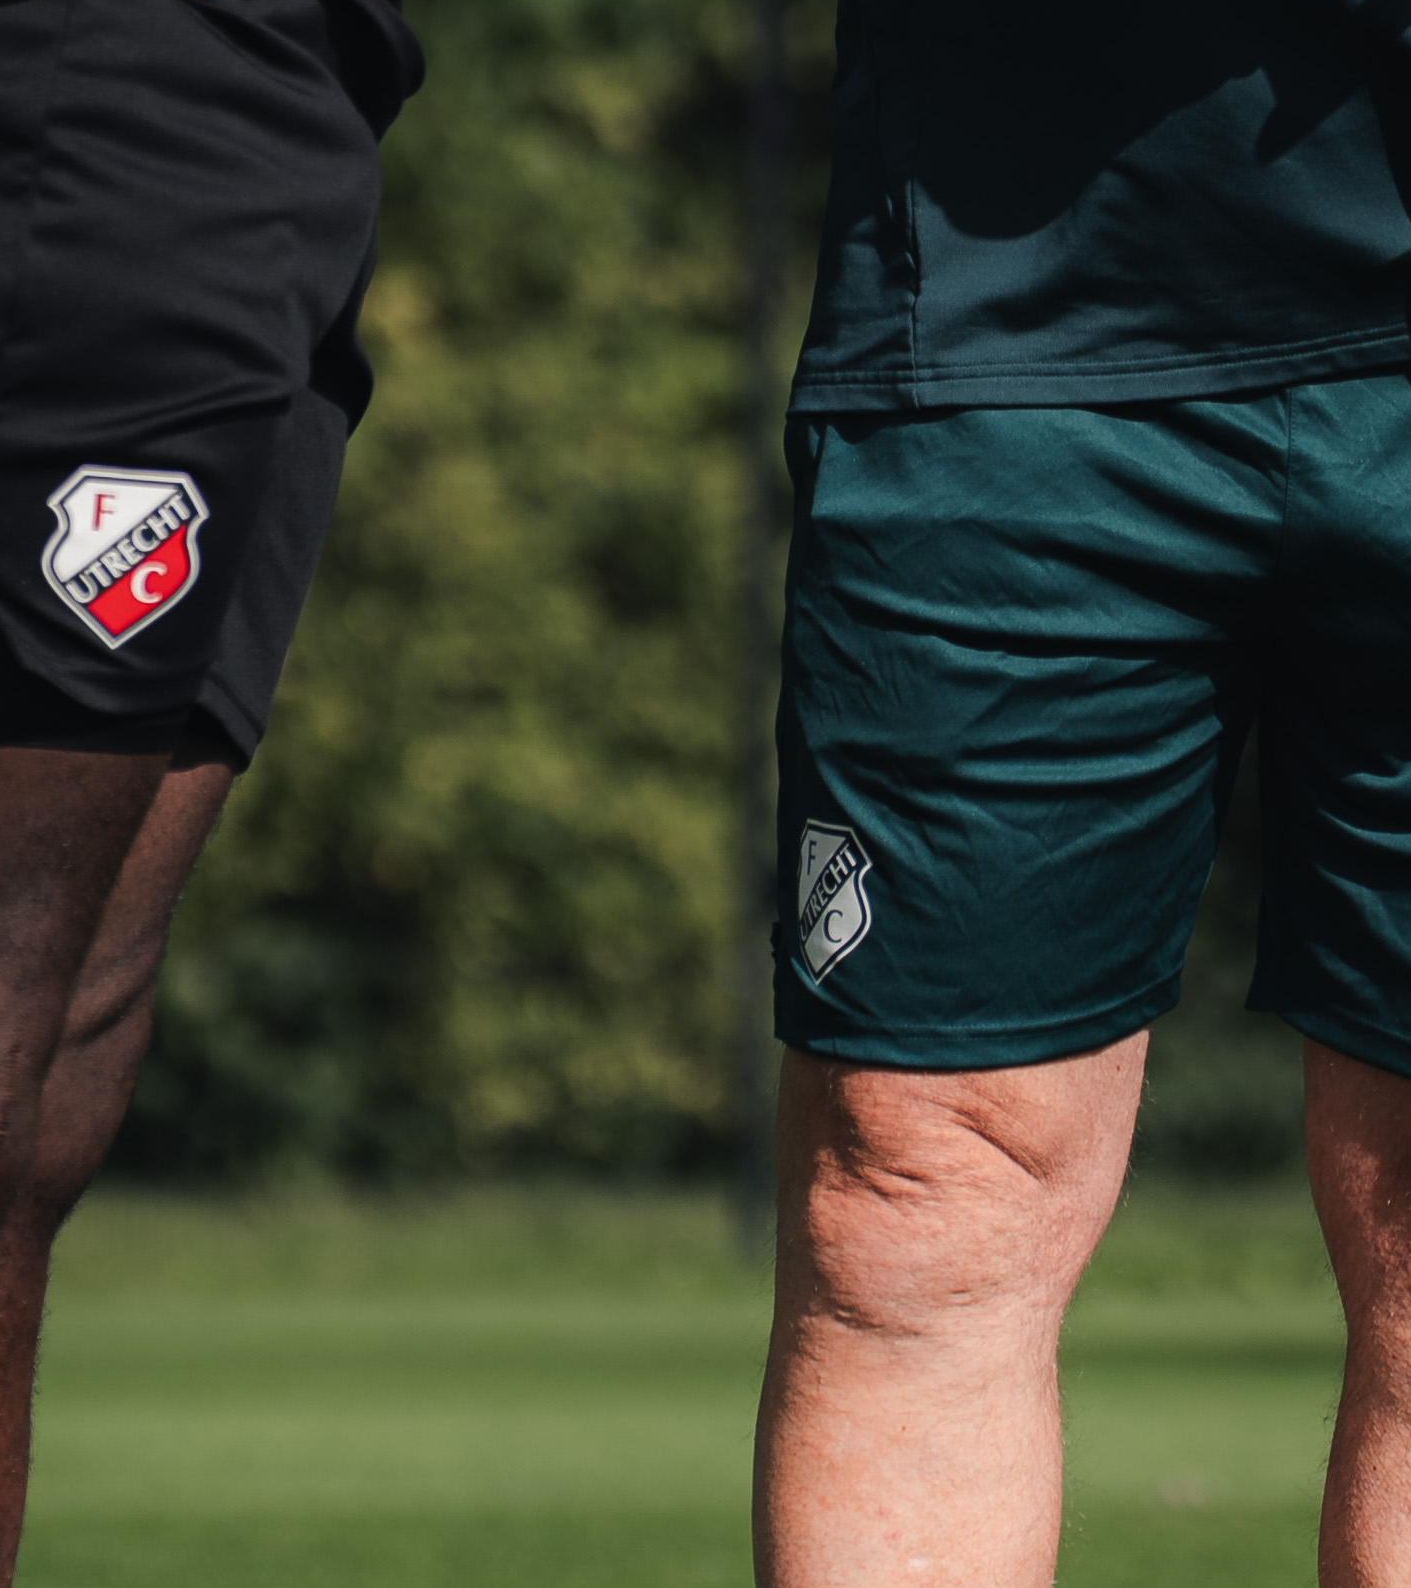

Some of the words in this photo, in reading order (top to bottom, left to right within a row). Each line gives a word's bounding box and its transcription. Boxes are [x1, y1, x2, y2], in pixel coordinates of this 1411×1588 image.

[91, 492, 116, 532] F
[65, 493, 191, 604] UTRECHT
[130, 561, 168, 604] C
[806, 839, 818, 876] F
[799, 842, 857, 942] UTRECHT
[823, 909, 844, 943] C
